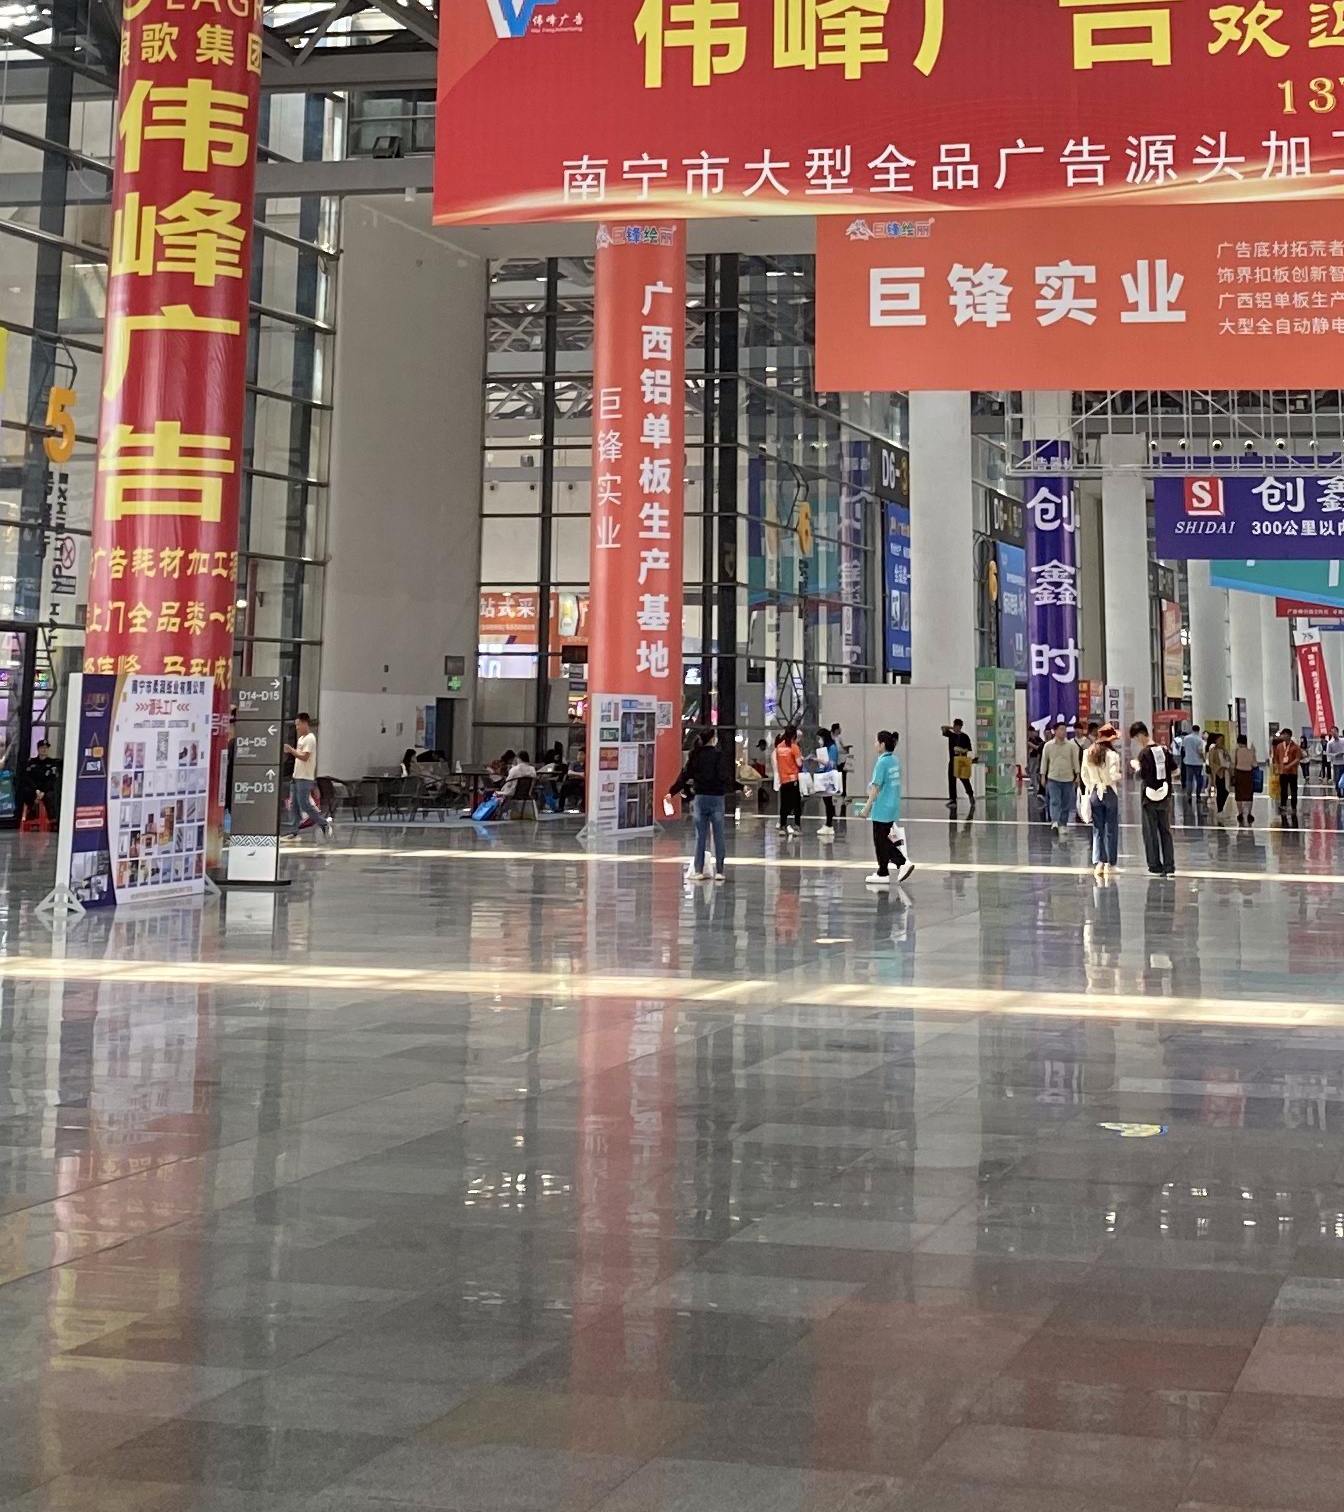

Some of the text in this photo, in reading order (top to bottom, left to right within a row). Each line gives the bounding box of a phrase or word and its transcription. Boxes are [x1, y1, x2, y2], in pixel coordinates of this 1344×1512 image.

[98, 78, 251, 522] 伟峰广告
[869, 259, 1186, 328] 巨锋实业
[44, 386, 77, 464] 5
[595, 388, 624, 550] 巨锋实业
[636, 281, 673, 679] 广西铝单板生产基地
[90, 546, 238, 582] 广告耗材加工
[1174, 520, 1236, 534] SHIDAI
